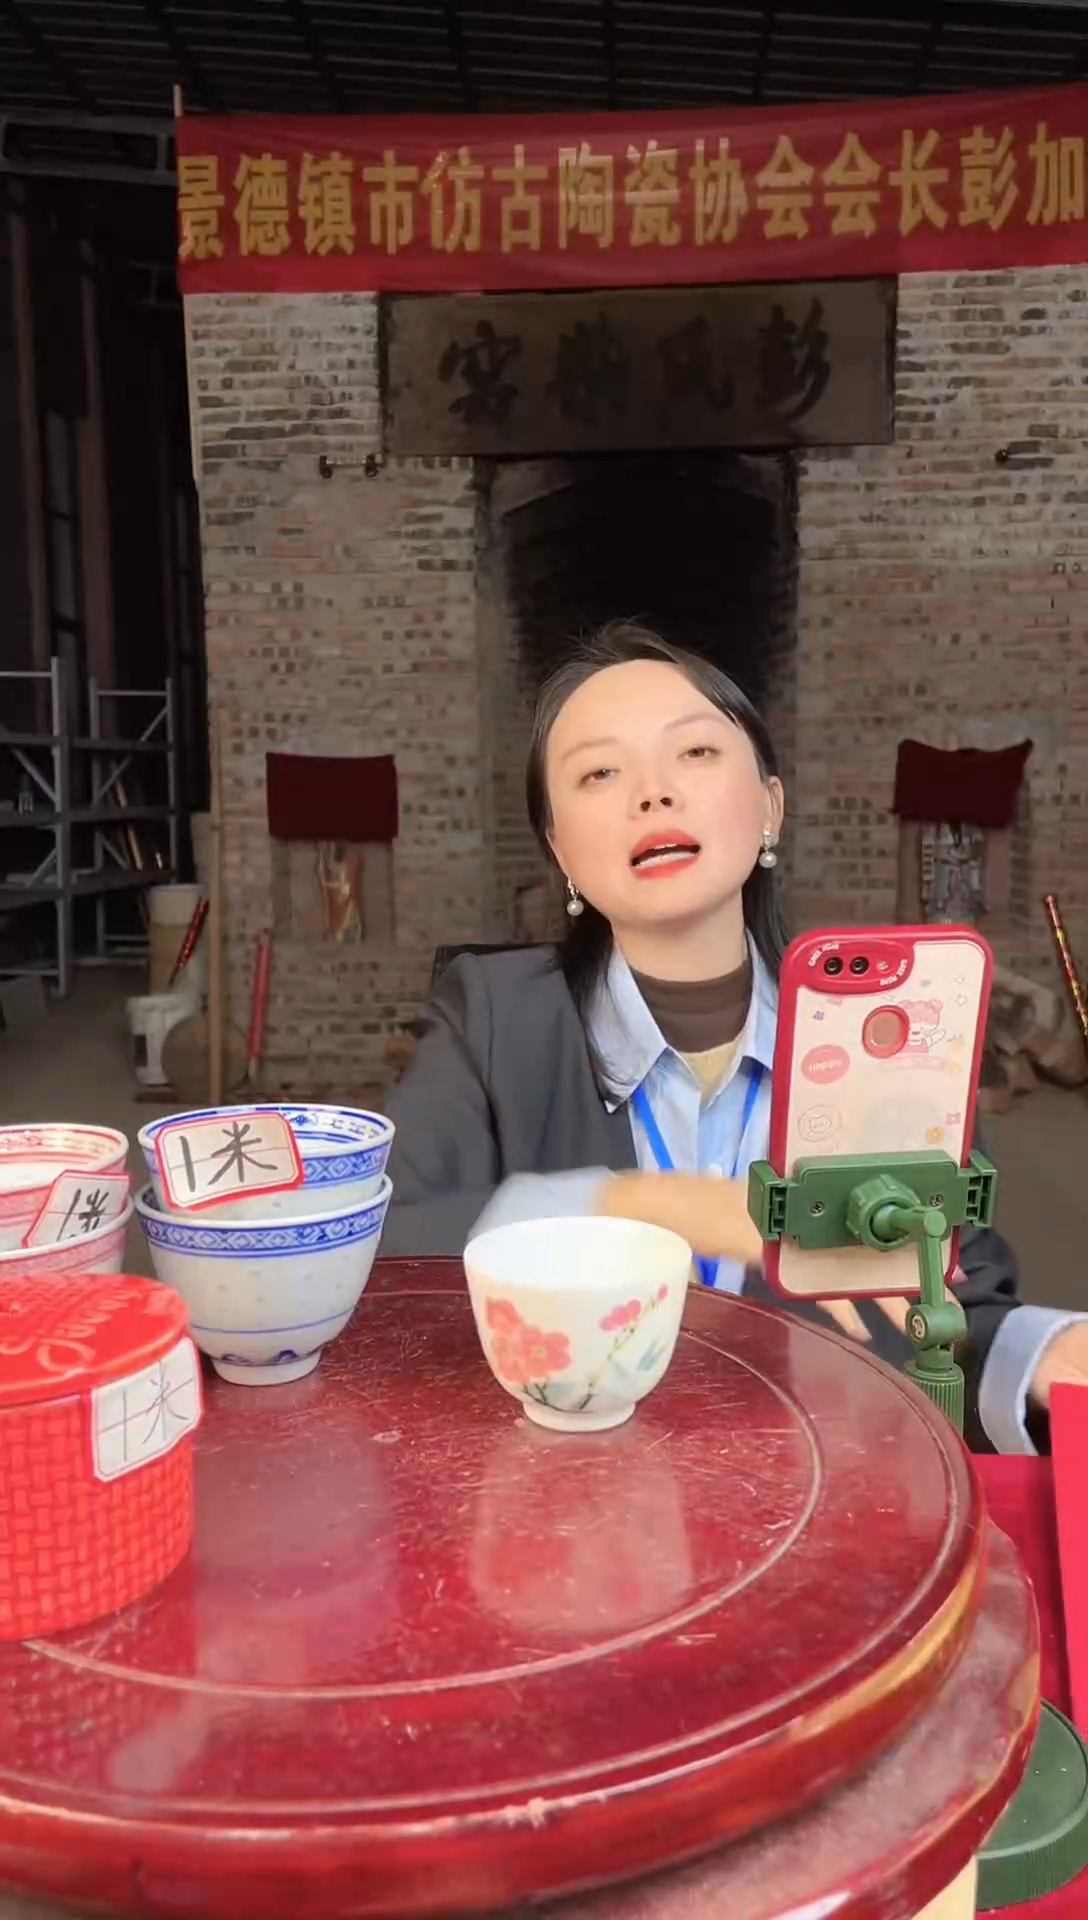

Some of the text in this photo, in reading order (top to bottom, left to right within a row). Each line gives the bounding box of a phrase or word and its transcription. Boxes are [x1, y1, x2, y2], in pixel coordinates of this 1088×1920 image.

[177, 121, 1085, 259] 景德镇市仿古陶瓷协会会长彭加
